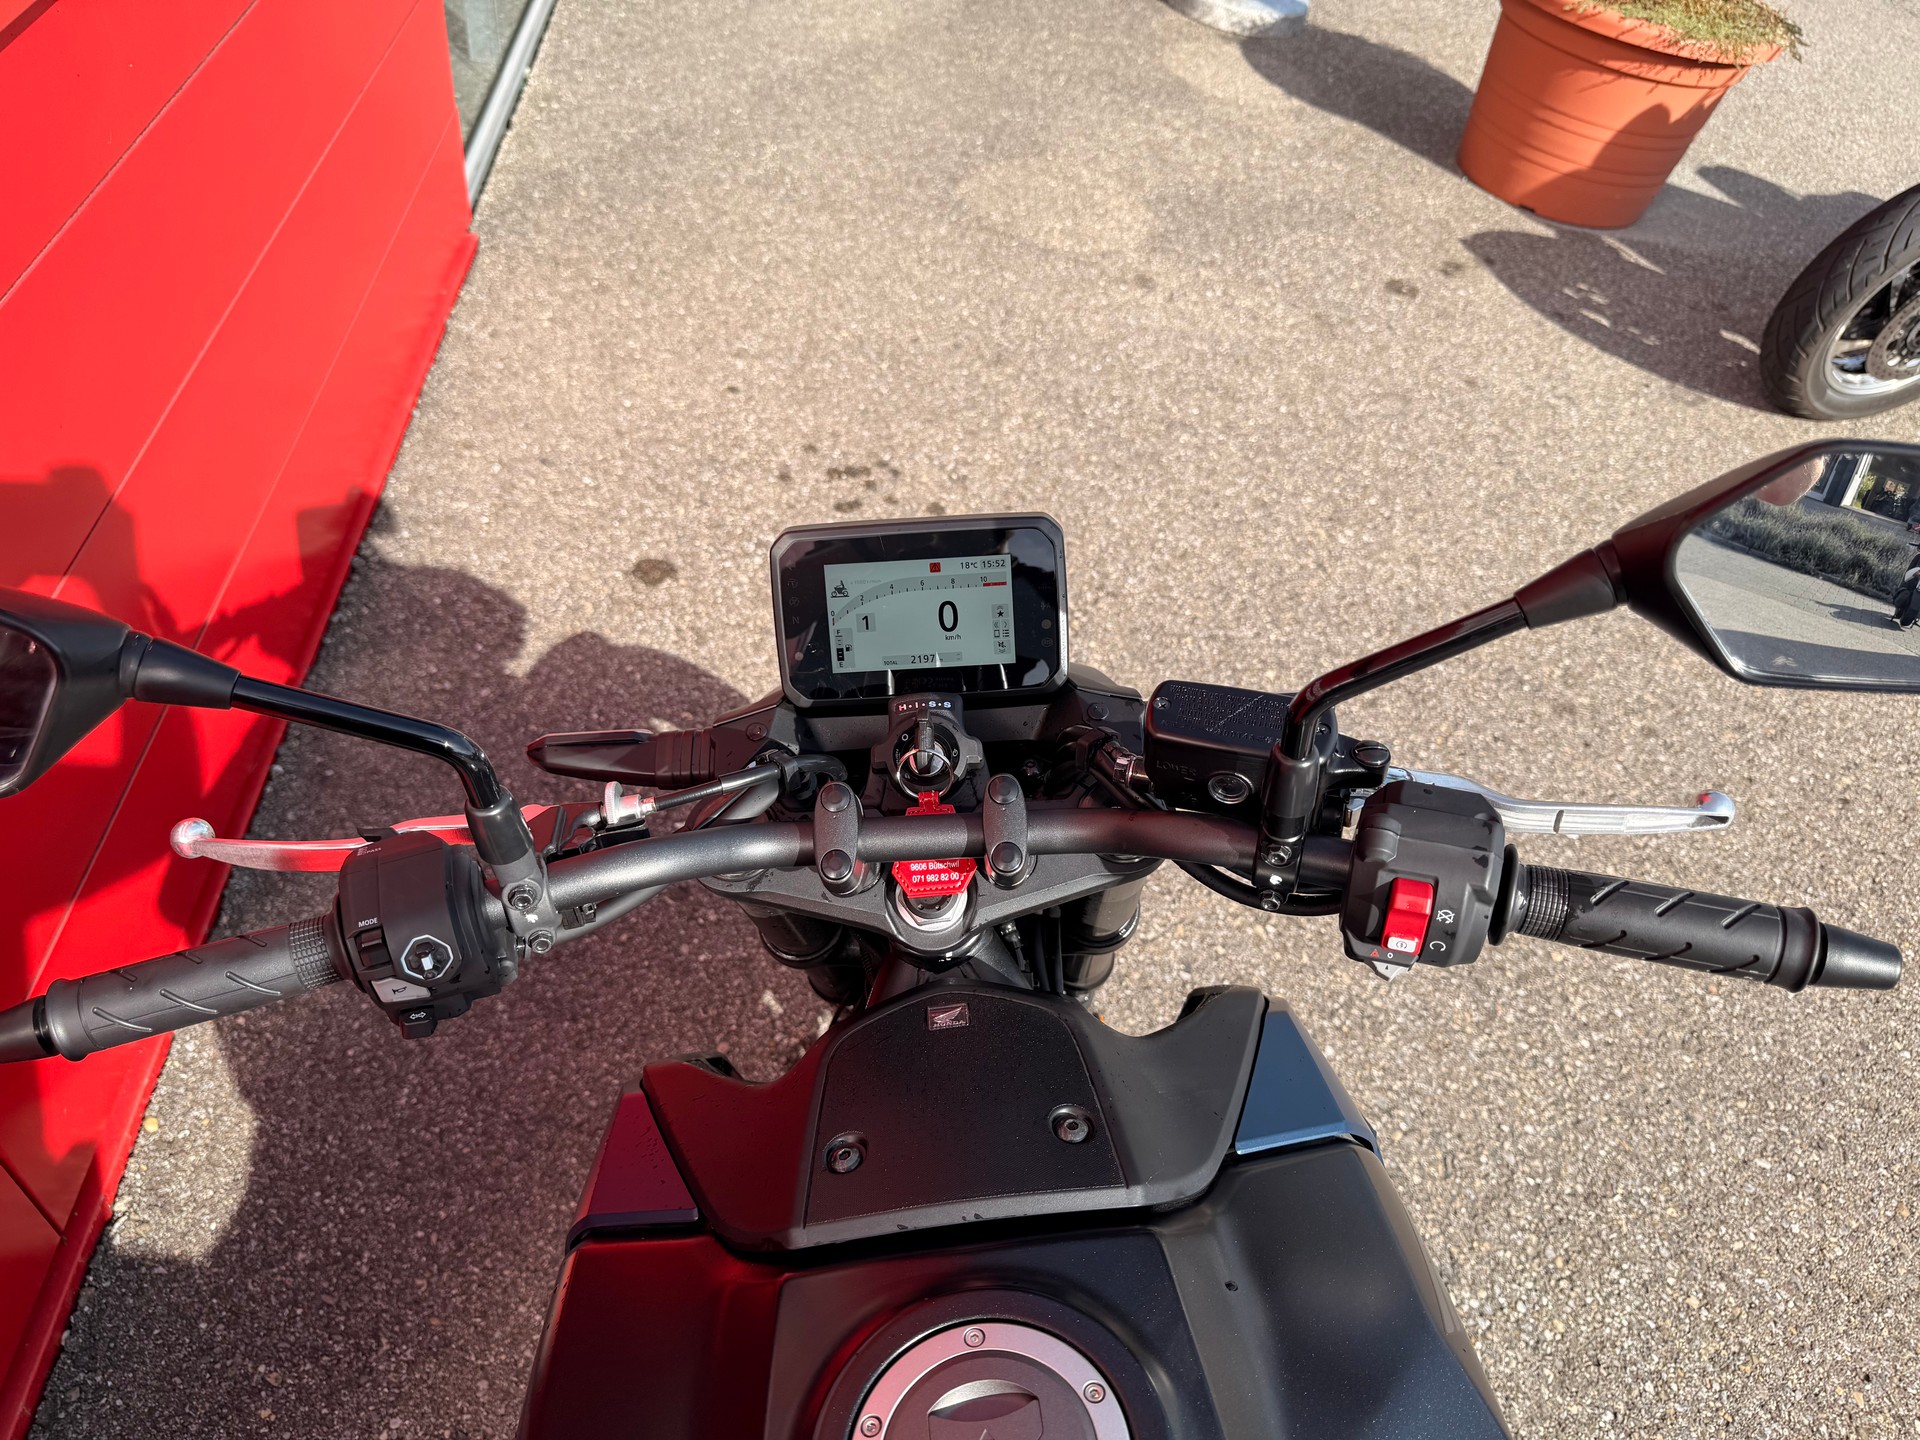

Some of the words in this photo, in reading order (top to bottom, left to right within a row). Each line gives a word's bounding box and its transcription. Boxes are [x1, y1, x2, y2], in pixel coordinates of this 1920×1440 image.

[961, 561, 978, 569] 18°C
[982, 560, 1006, 568] 15:52
[938, 600, 959, 633] 0
[861, 615, 870, 631] 1
[910, 654, 936, 665] 2197
[1156, 761, 1197, 776] LOWER
[910, 862, 927, 871] 9606
[912, 875, 925, 883] 071
[926, 874, 939, 882] 982
[940, 873, 949, 881] 82
[950, 872, 960, 880] 00
[358, 917, 378, 928] MODE
